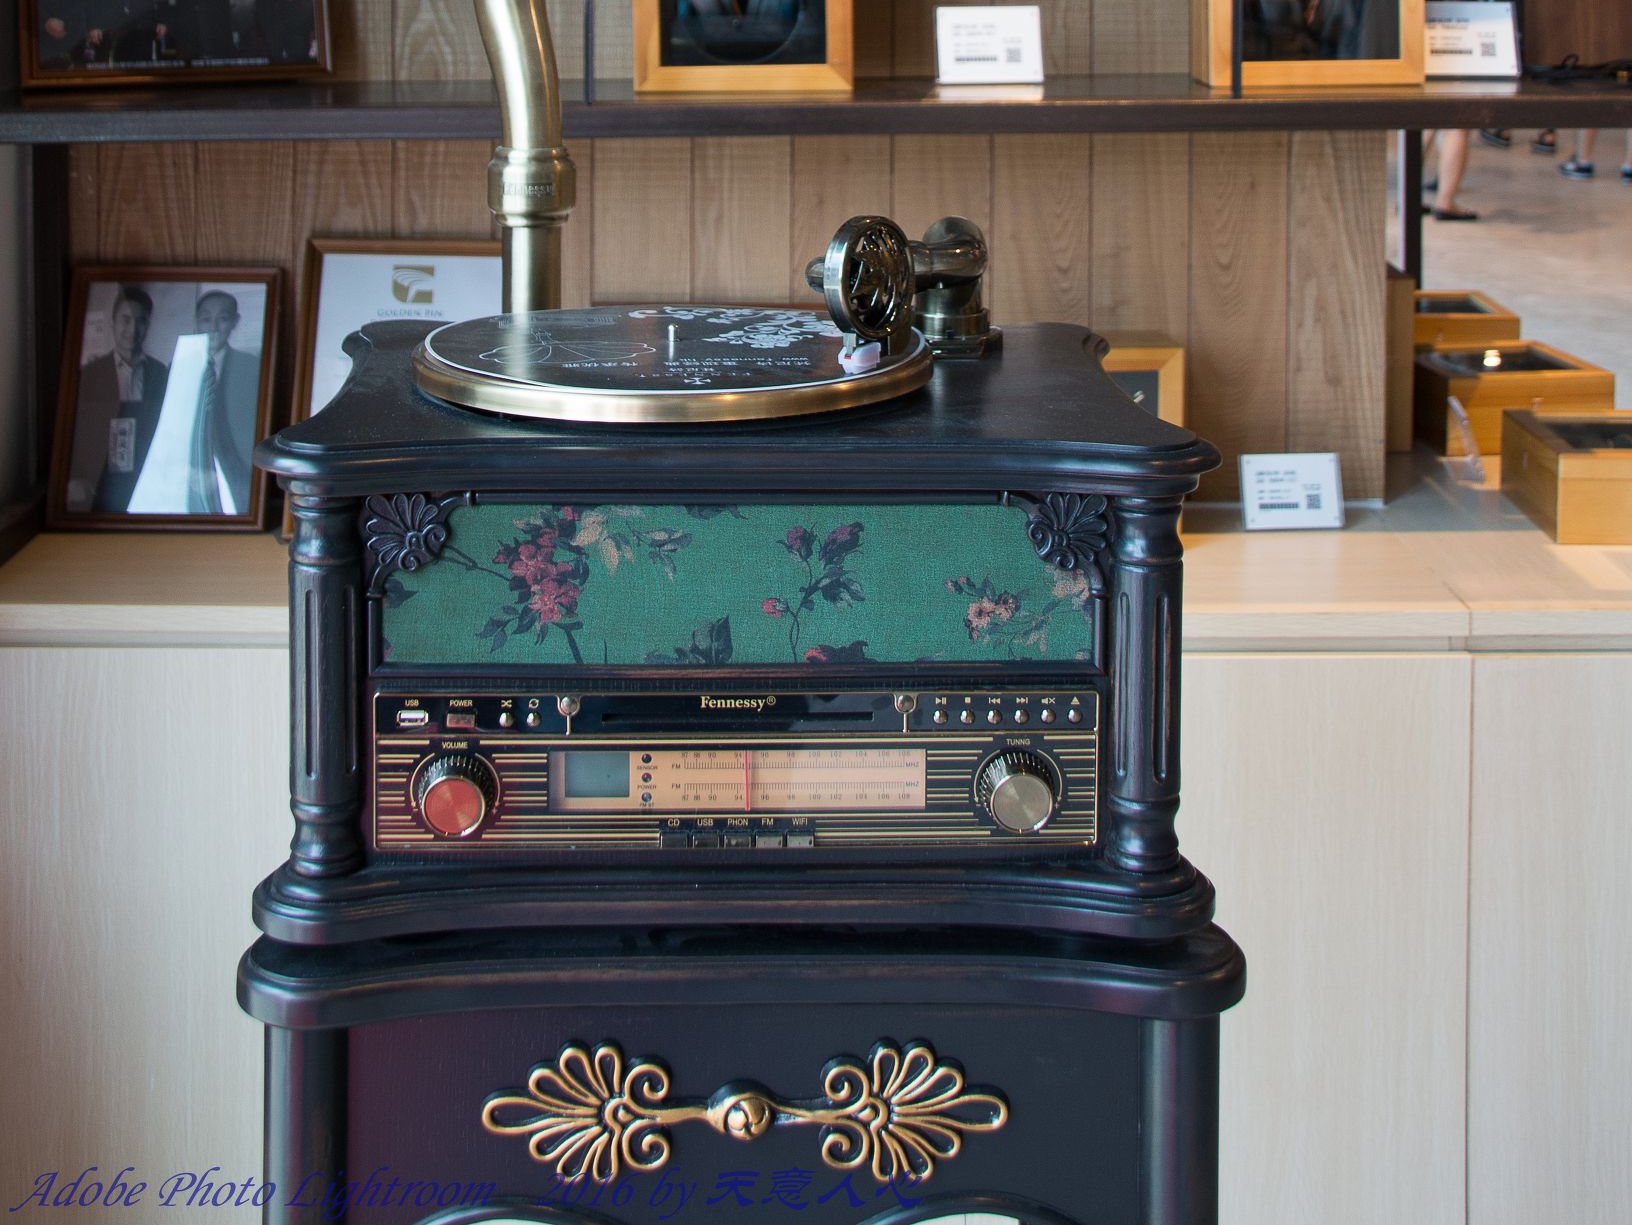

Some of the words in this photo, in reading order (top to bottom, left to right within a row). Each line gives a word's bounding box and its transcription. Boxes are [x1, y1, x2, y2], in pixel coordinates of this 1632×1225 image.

[404, 699, 419, 707] USB
[449, 699, 473, 707] POWER
[441, 741, 468, 750] VOLUME
[667, 818, 680, 826] CD
[697, 818, 714, 826] USB
[727, 818, 749, 826] PHON
[761, 818, 774, 826] FM
